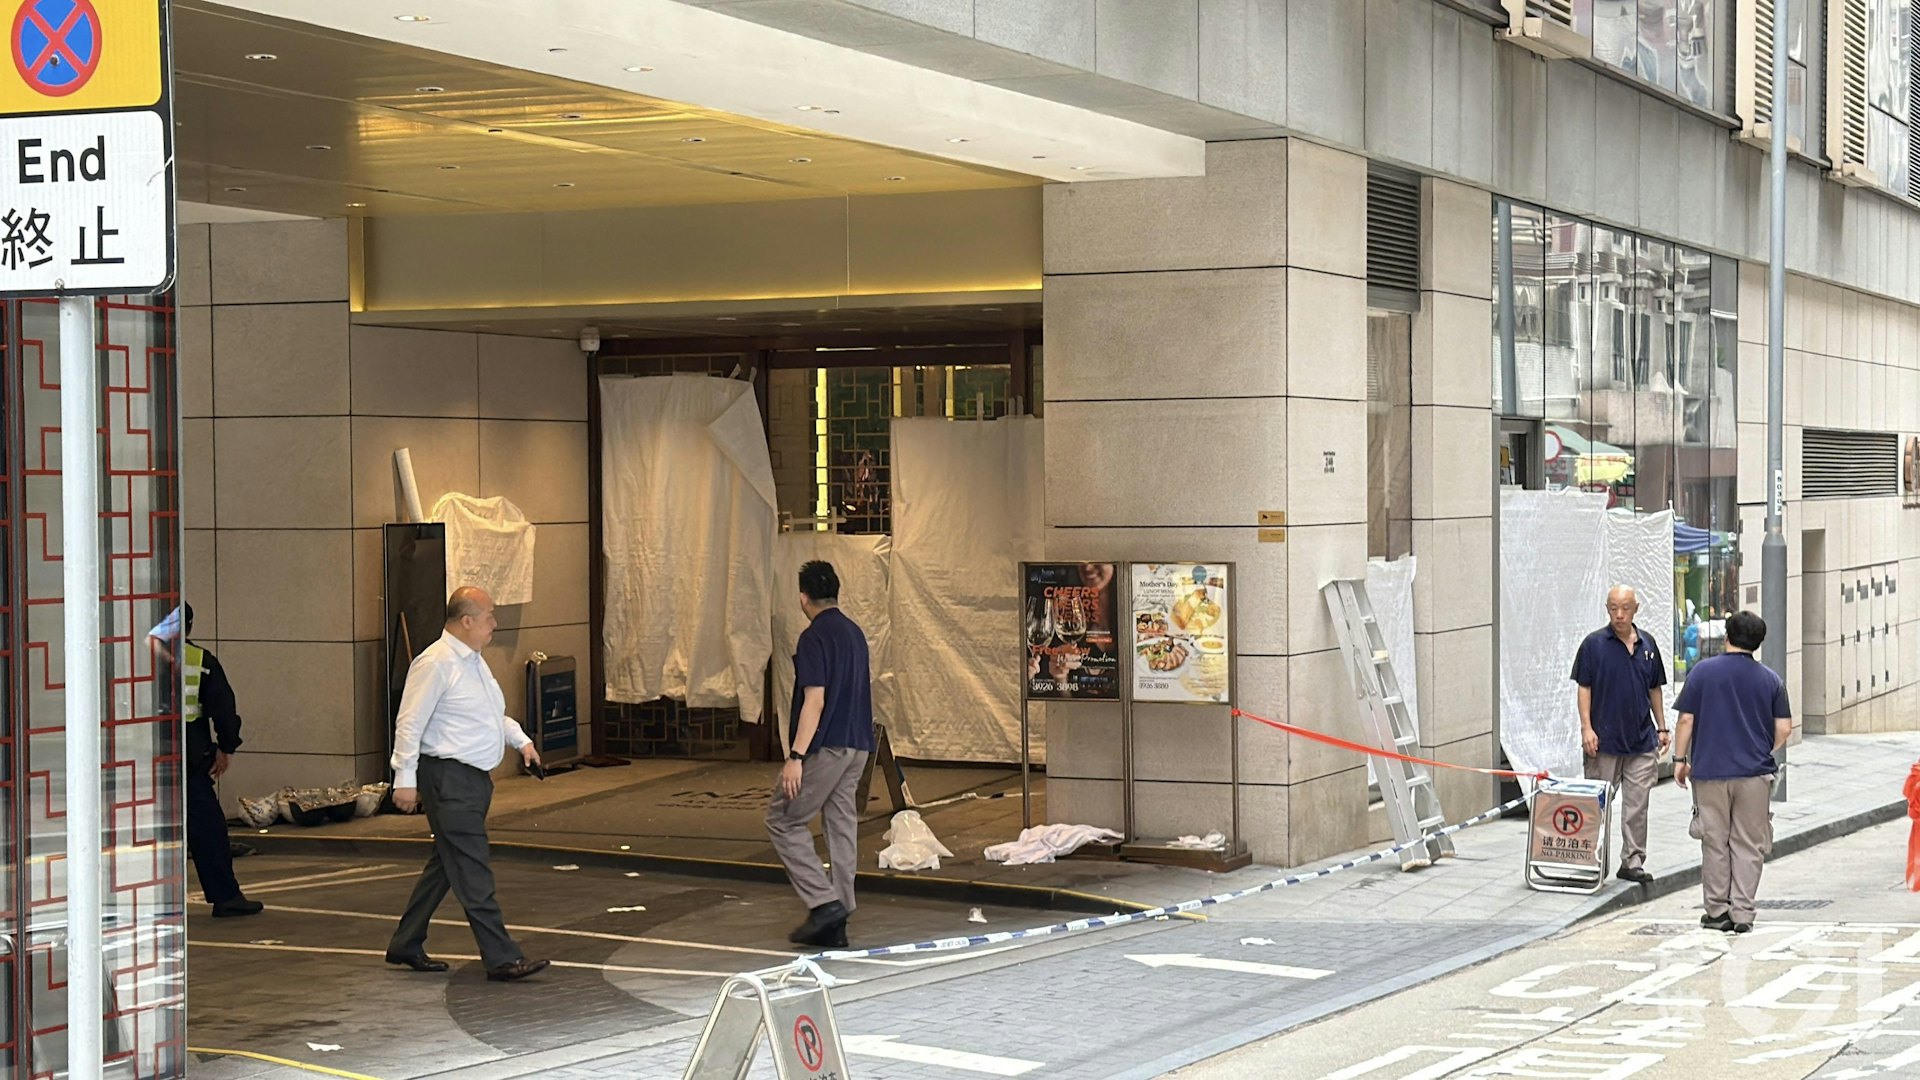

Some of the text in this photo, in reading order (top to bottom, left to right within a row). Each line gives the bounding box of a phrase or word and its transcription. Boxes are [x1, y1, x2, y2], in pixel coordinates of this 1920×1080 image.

[18, 135, 106, 184] End
[1, 206, 125, 271] 終止
[1140, 580, 1178, 589] Mother's Day
[1044, 586, 1099, 598] CHEERS
[1032, 645, 1058, 656] Free
[1080, 652, 1117, 663] Promotion
[1542, 836, 1592, 849] 请勿泊车
[1541, 850, 1591, 860] NO PARKING
